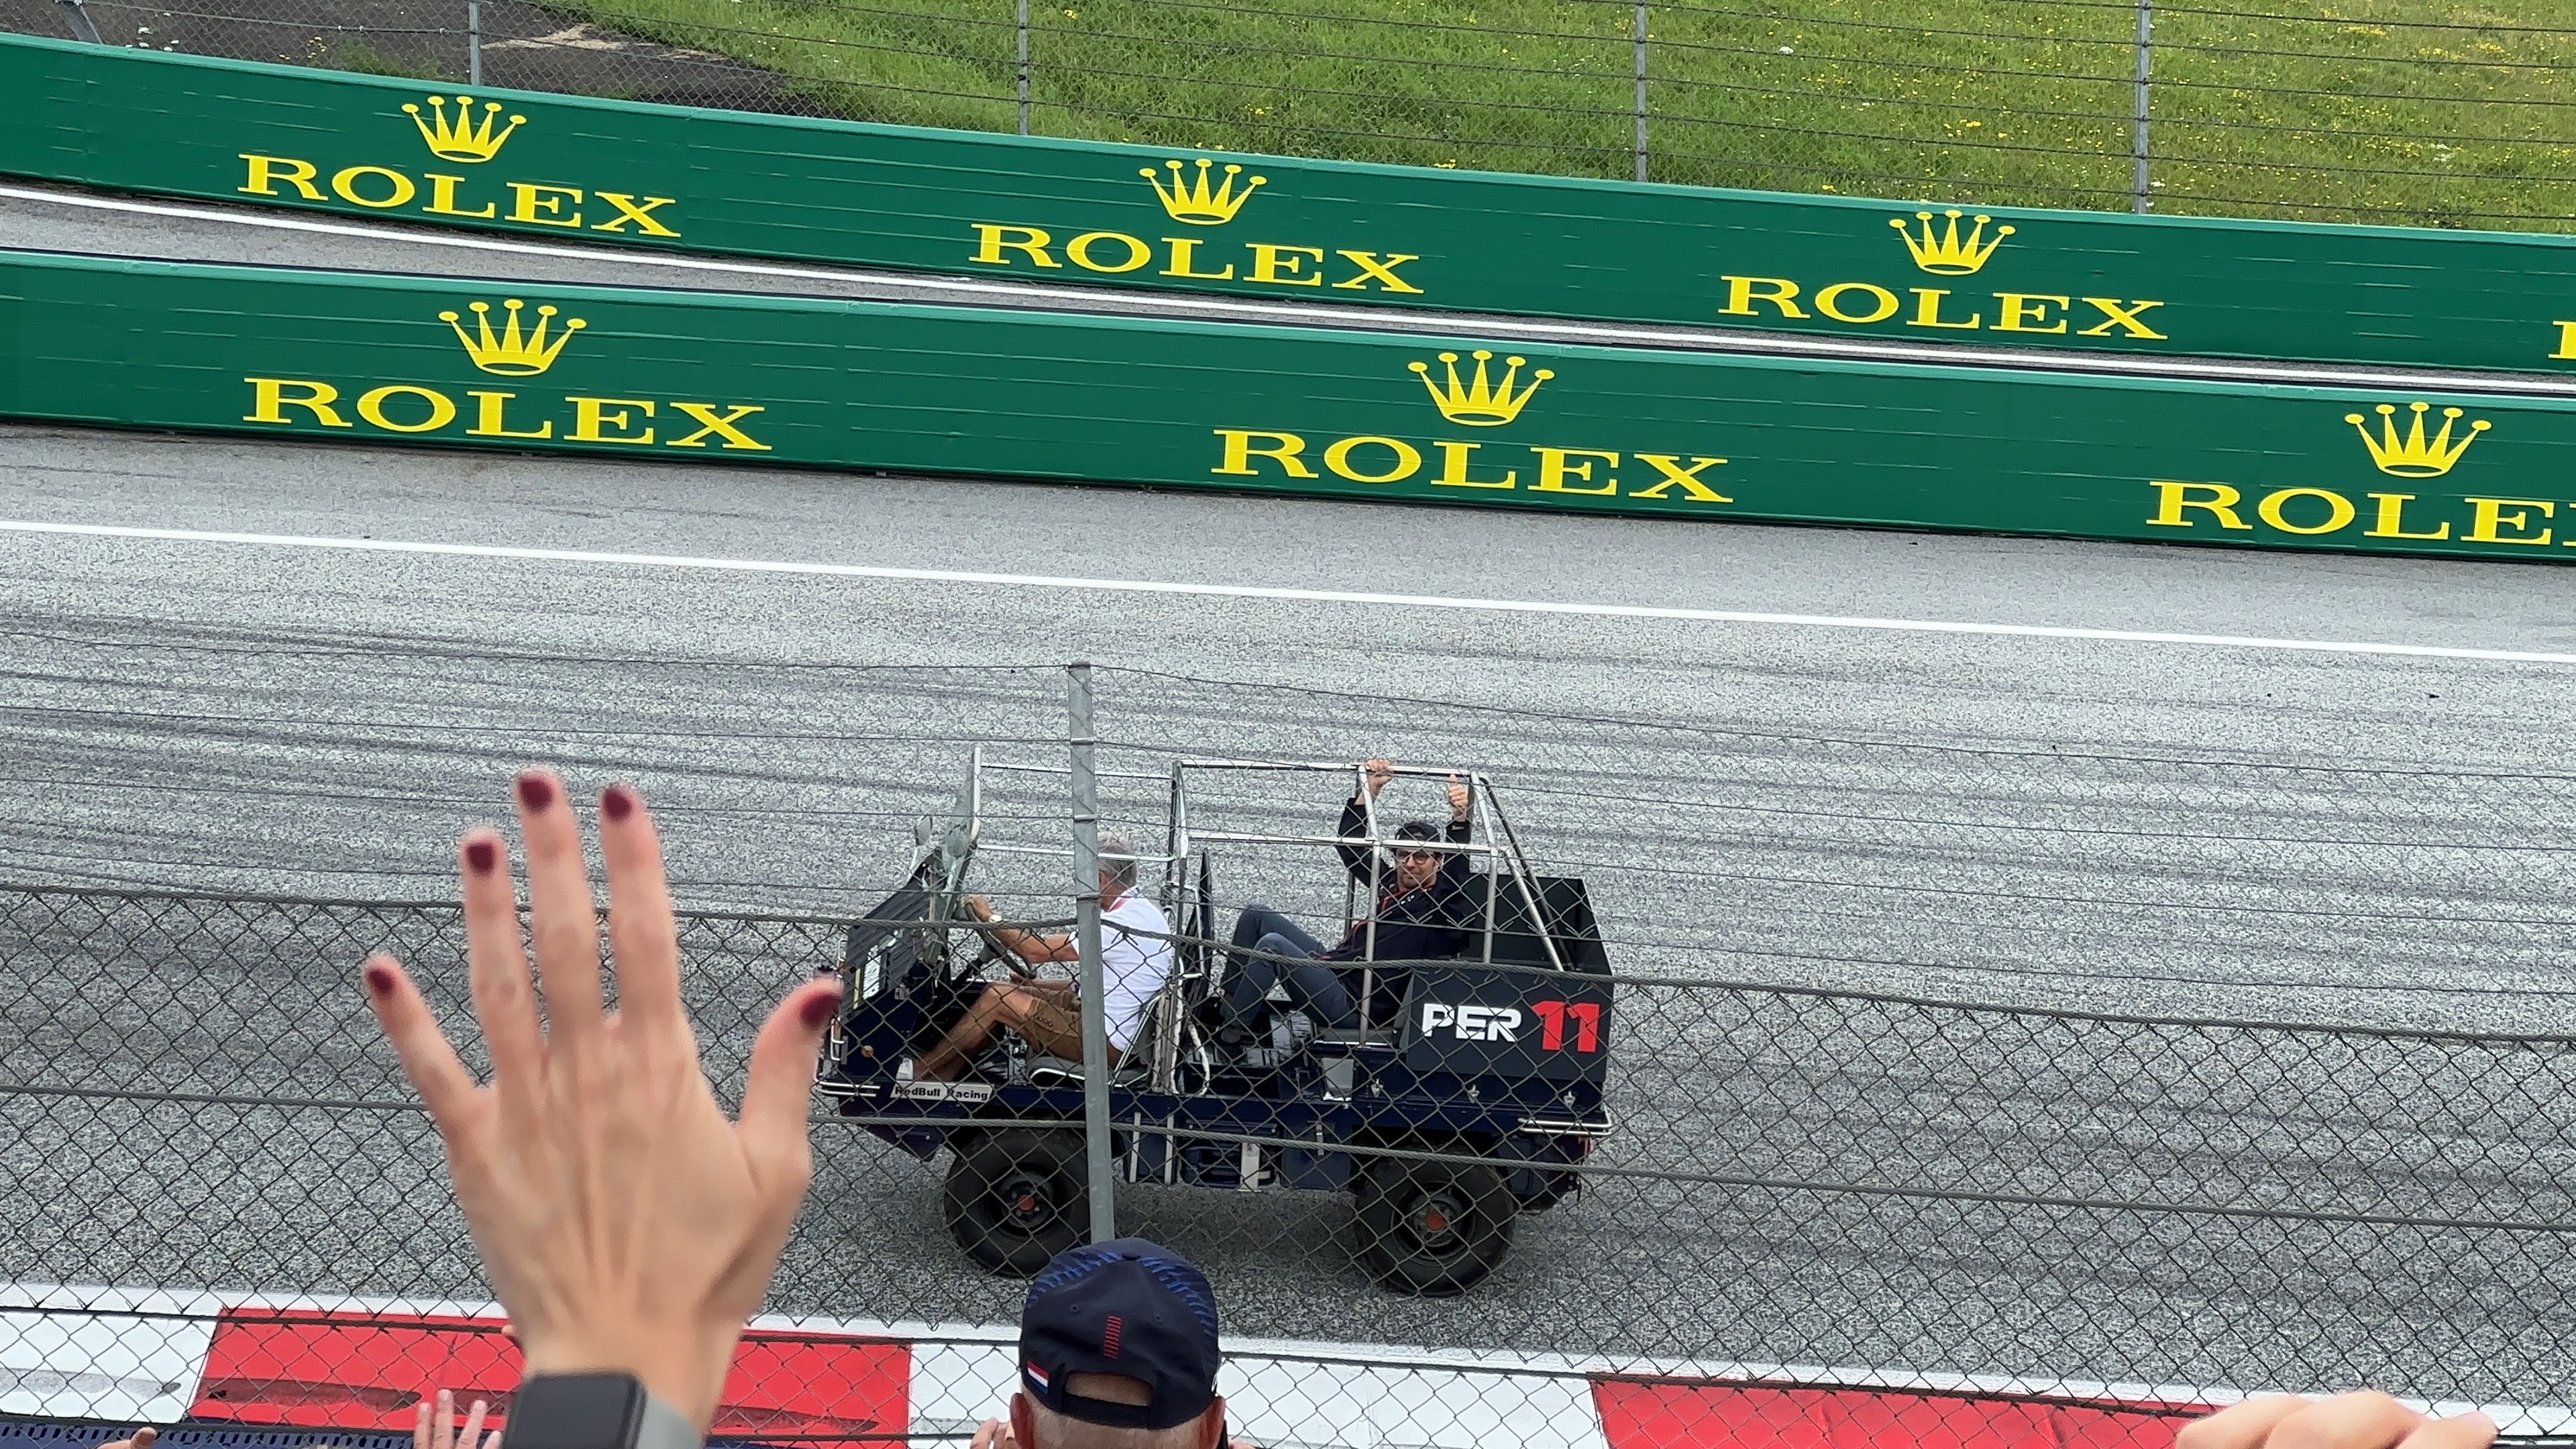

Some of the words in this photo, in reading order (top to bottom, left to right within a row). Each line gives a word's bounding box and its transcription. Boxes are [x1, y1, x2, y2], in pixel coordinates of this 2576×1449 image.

[237, 154, 683, 237] ROLEX
[968, 223, 1425, 294] ROLEX
[1717, 274, 2168, 340] ROLEX
[242, 376, 773, 451] ROLEX
[1211, 430, 1733, 503] ROLEX
[2145, 480, 2576, 547] ROLE
[1421, 1003, 1522, 1043] PER
[1532, 1000, 1601, 1053] 11
